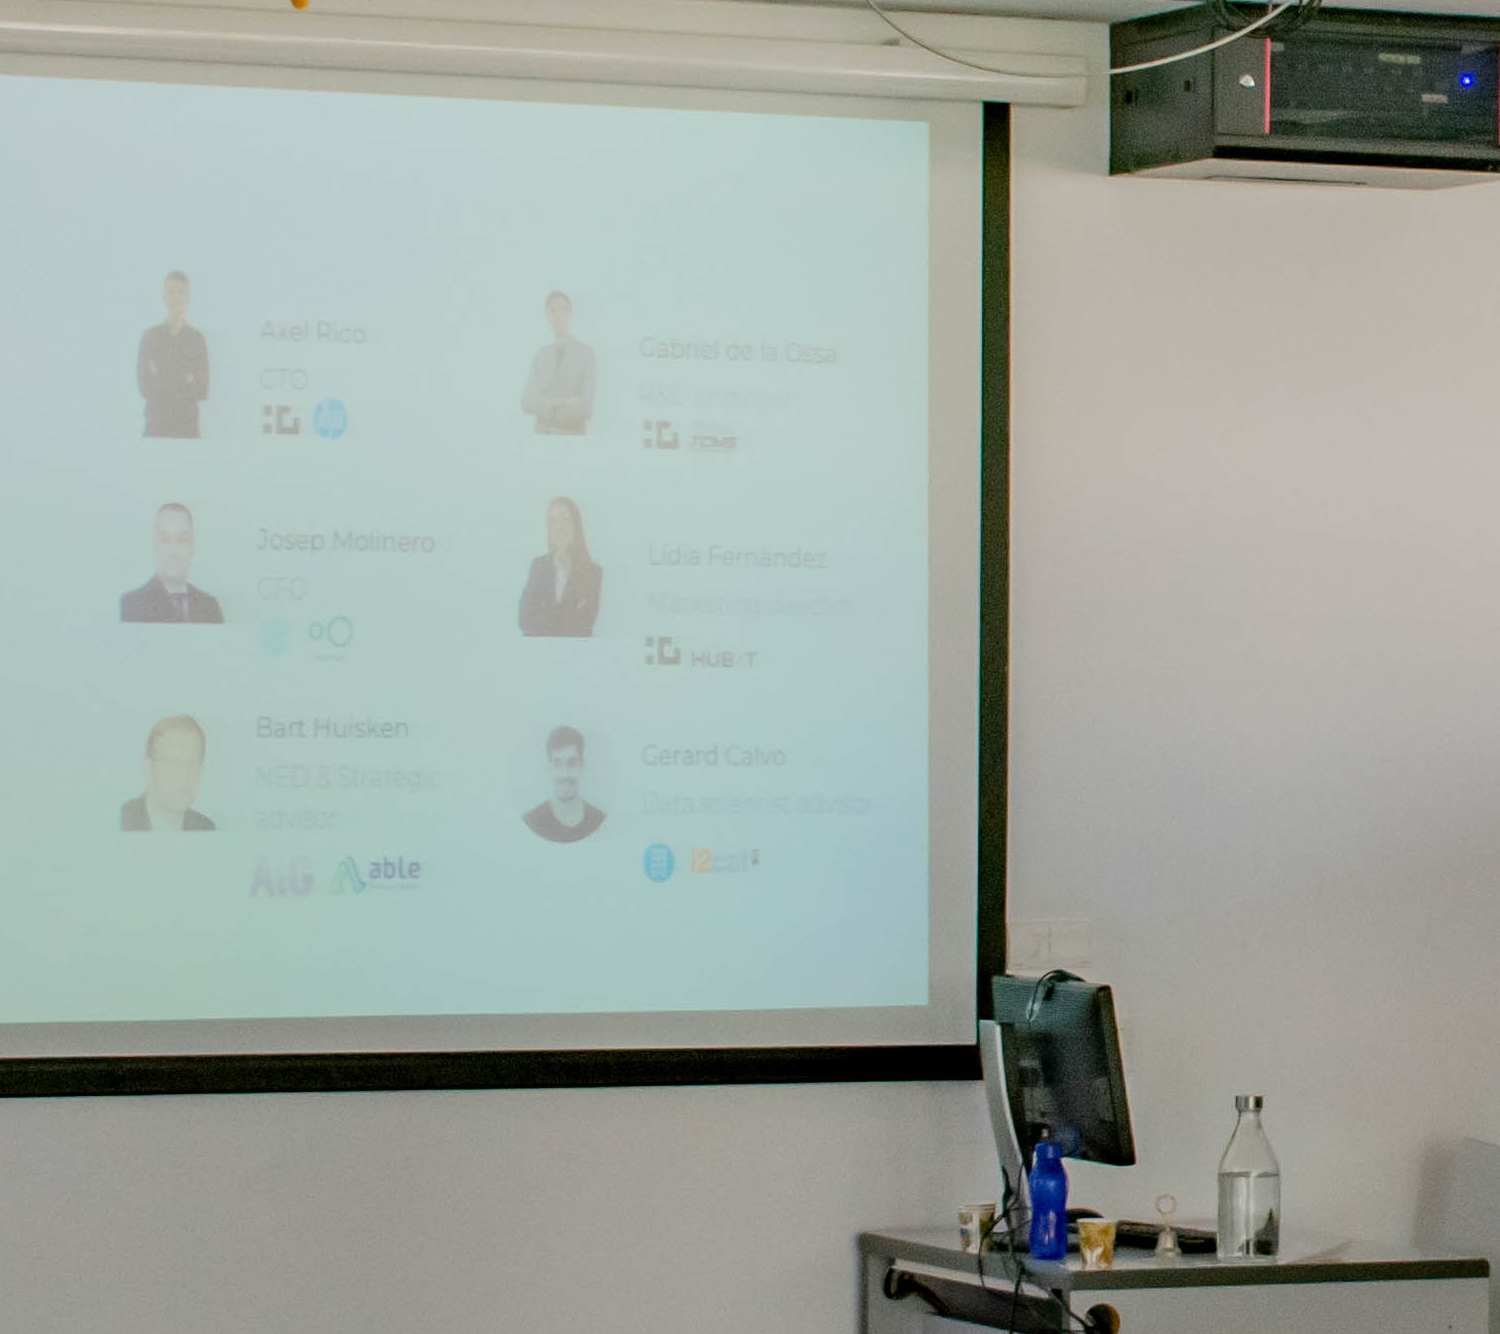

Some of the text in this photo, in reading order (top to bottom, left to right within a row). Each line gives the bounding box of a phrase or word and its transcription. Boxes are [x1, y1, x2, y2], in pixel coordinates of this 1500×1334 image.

[259, 320, 368, 345] Axel Rico
[725, 339, 753, 362] de
[760, 339, 779, 362] la
[255, 528, 436, 555] Josep Molinero
[256, 715, 410, 740] Bart Huisken
[641, 744, 787, 767] Gerard Calvo
[367, 855, 422, 880] able
